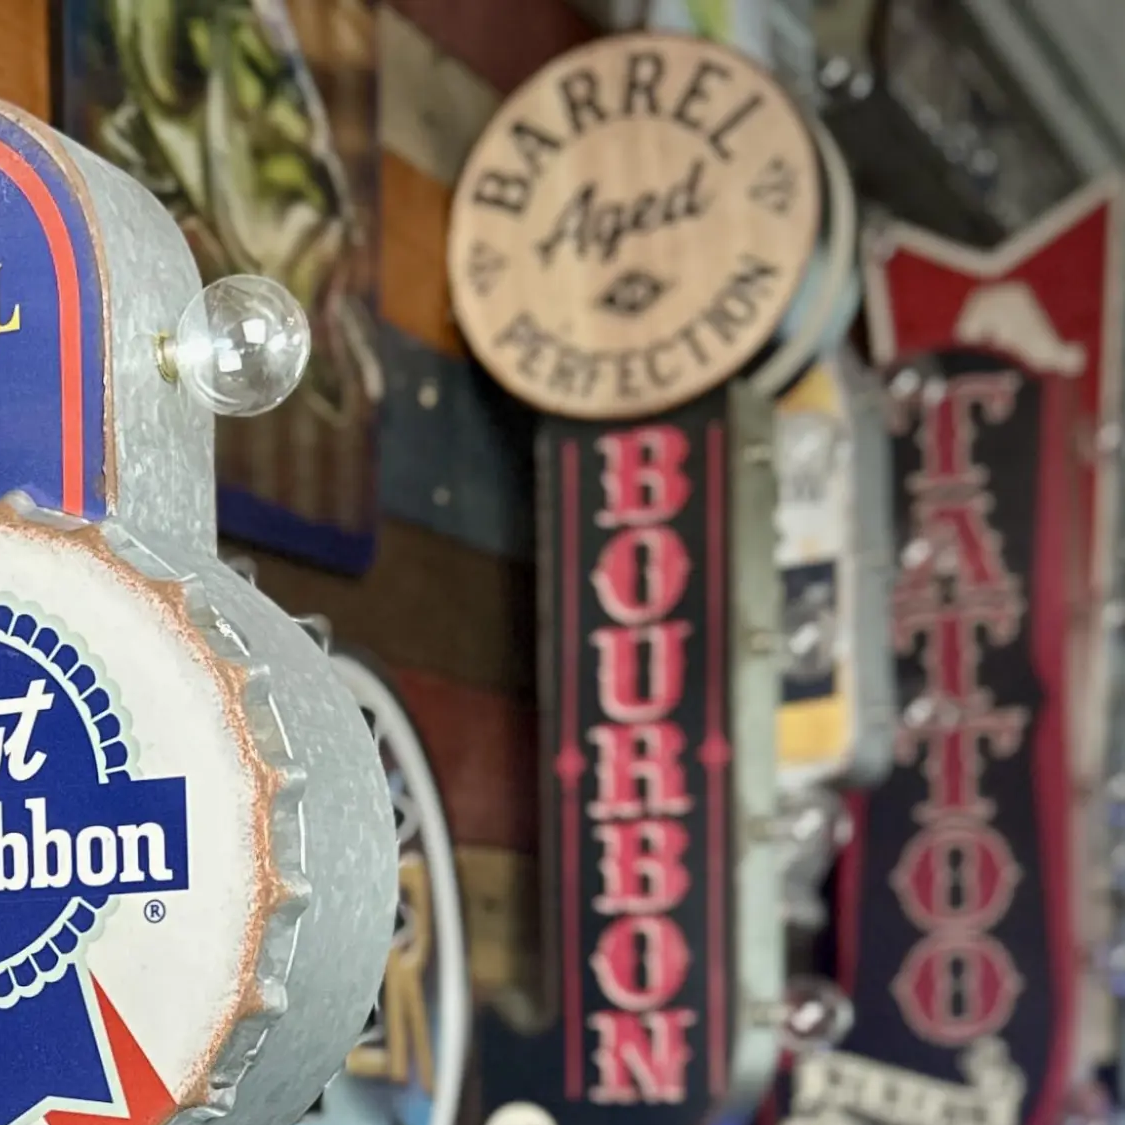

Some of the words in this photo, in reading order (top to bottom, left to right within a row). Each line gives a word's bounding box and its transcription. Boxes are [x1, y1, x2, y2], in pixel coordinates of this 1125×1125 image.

[473, 51, 764, 216] BARREL
[535, 158, 711, 269] Aged
[493, 253, 777, 400] PERFECTION
[589, 426, 694, 1105] BOURBON
[887, 370, 1027, 1047] TATTOO
